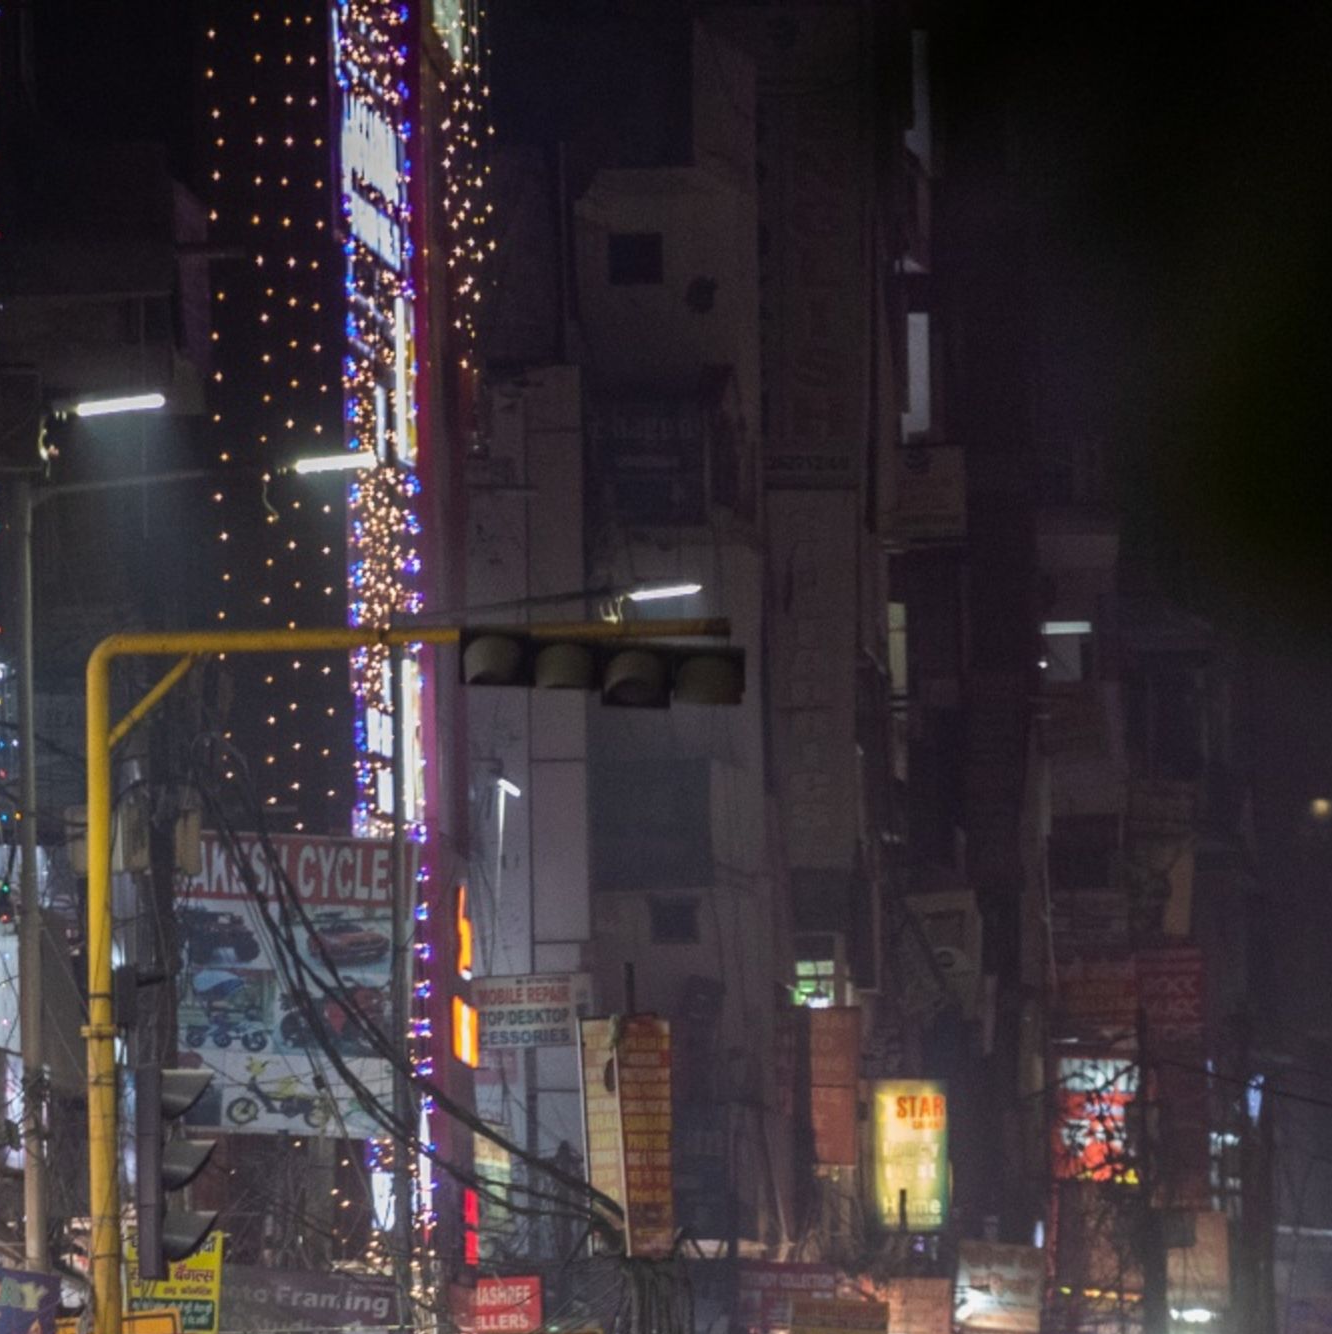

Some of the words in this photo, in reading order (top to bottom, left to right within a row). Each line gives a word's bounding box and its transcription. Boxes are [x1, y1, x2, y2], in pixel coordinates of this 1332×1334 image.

[191, 841, 289, 896] AKESH
[298, 844, 393, 900] CYCLE
[481, 1027, 570, 1045] CESSORIES
[896, 1095, 945, 1119] STAR
